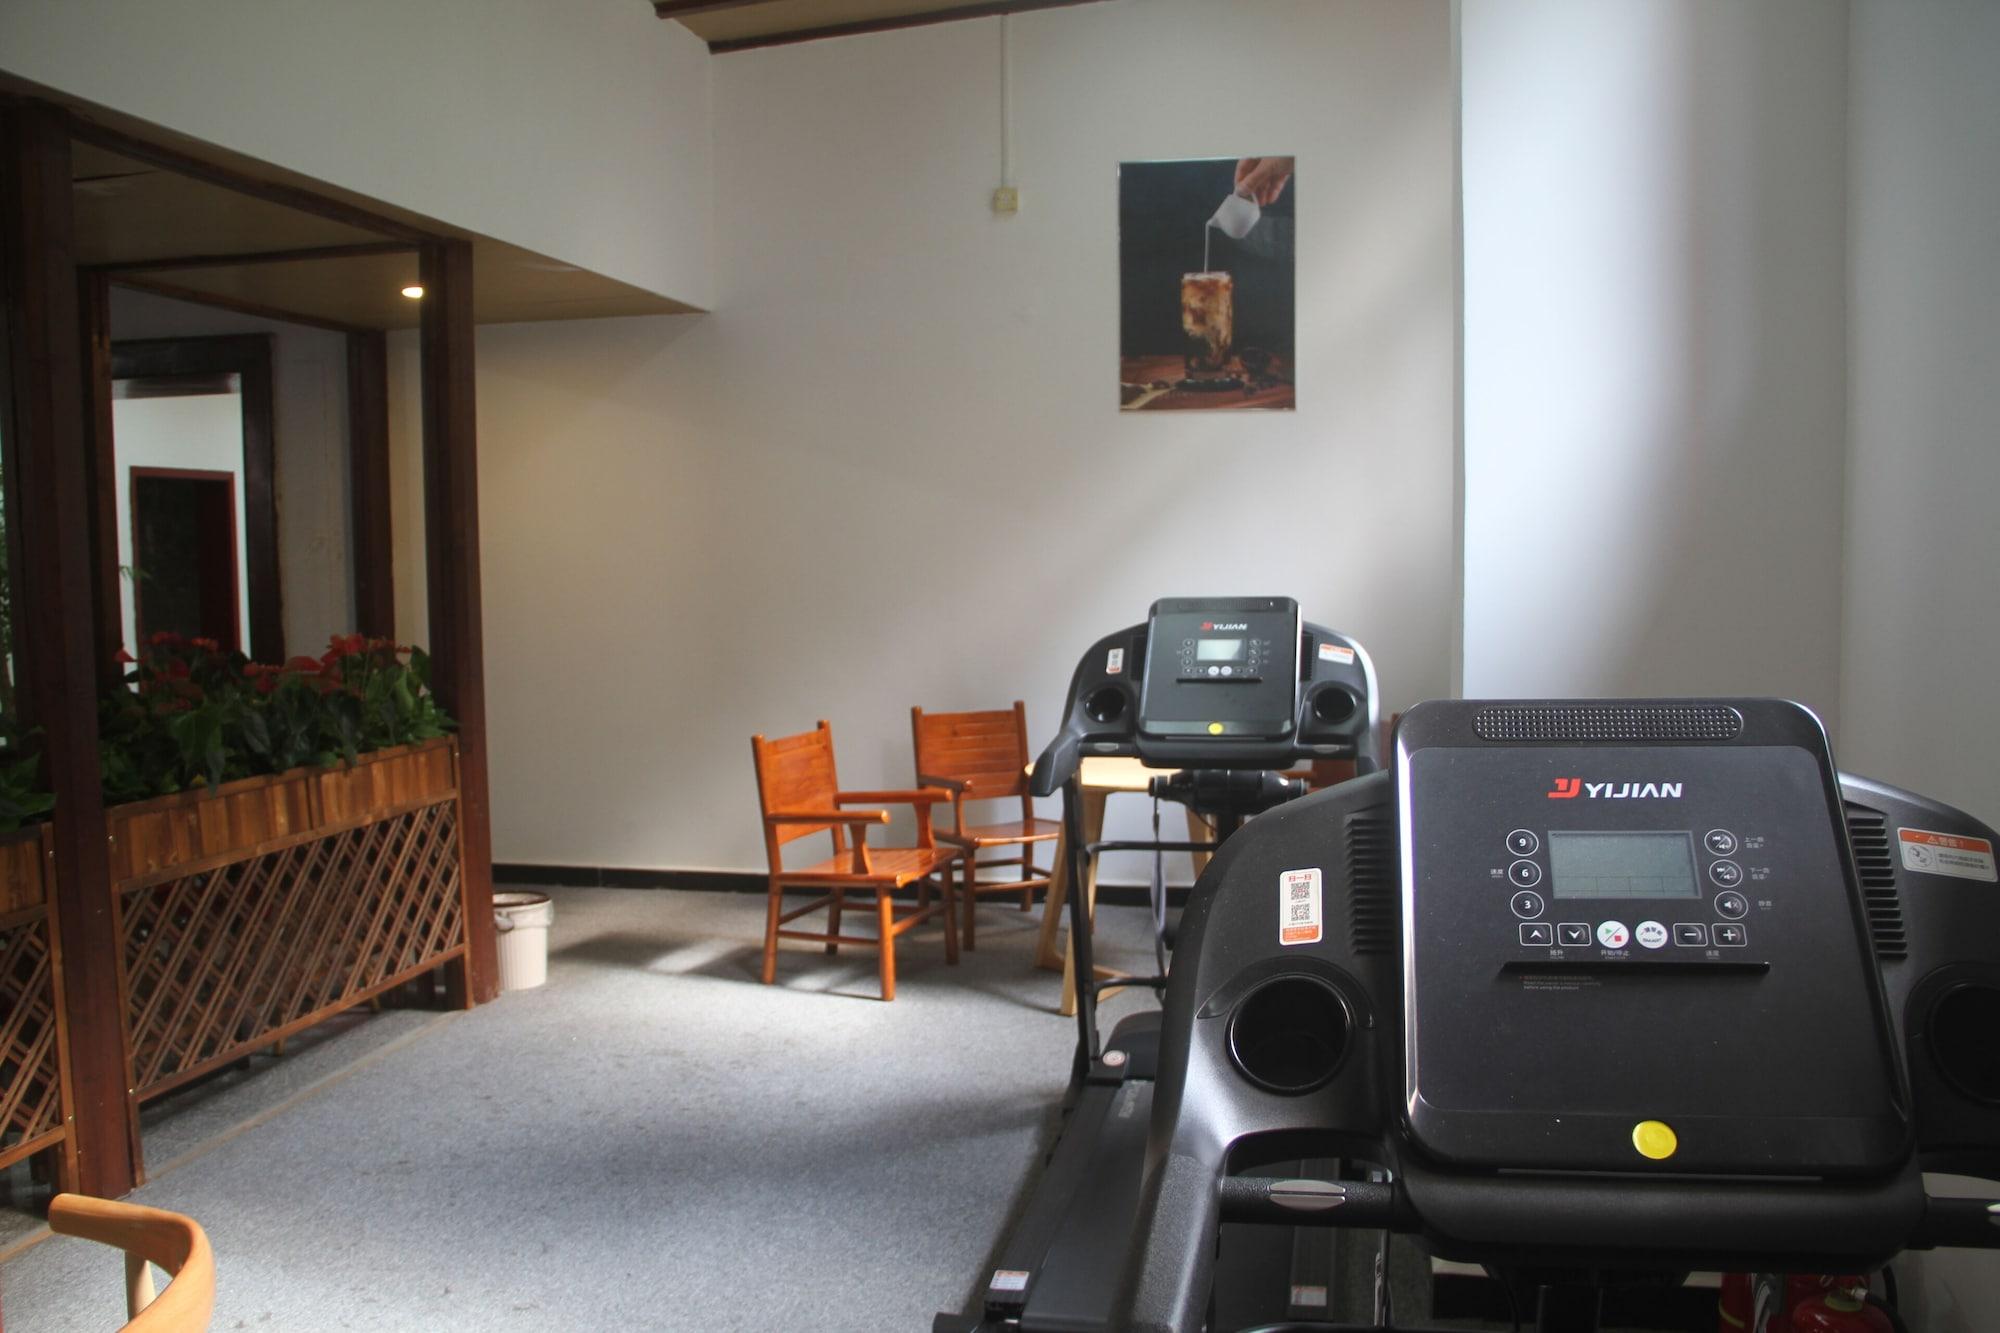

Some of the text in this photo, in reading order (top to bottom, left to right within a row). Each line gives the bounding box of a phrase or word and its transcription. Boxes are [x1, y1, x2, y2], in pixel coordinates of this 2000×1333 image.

[1213, 623, 1248, 631] YIJIAN
[1584, 782, 1683, 799] YIJIAN
[1519, 838, 1527, 847] 9
[1521, 868, 1529, 878] 6
[1524, 900, 1532, 909] 3
